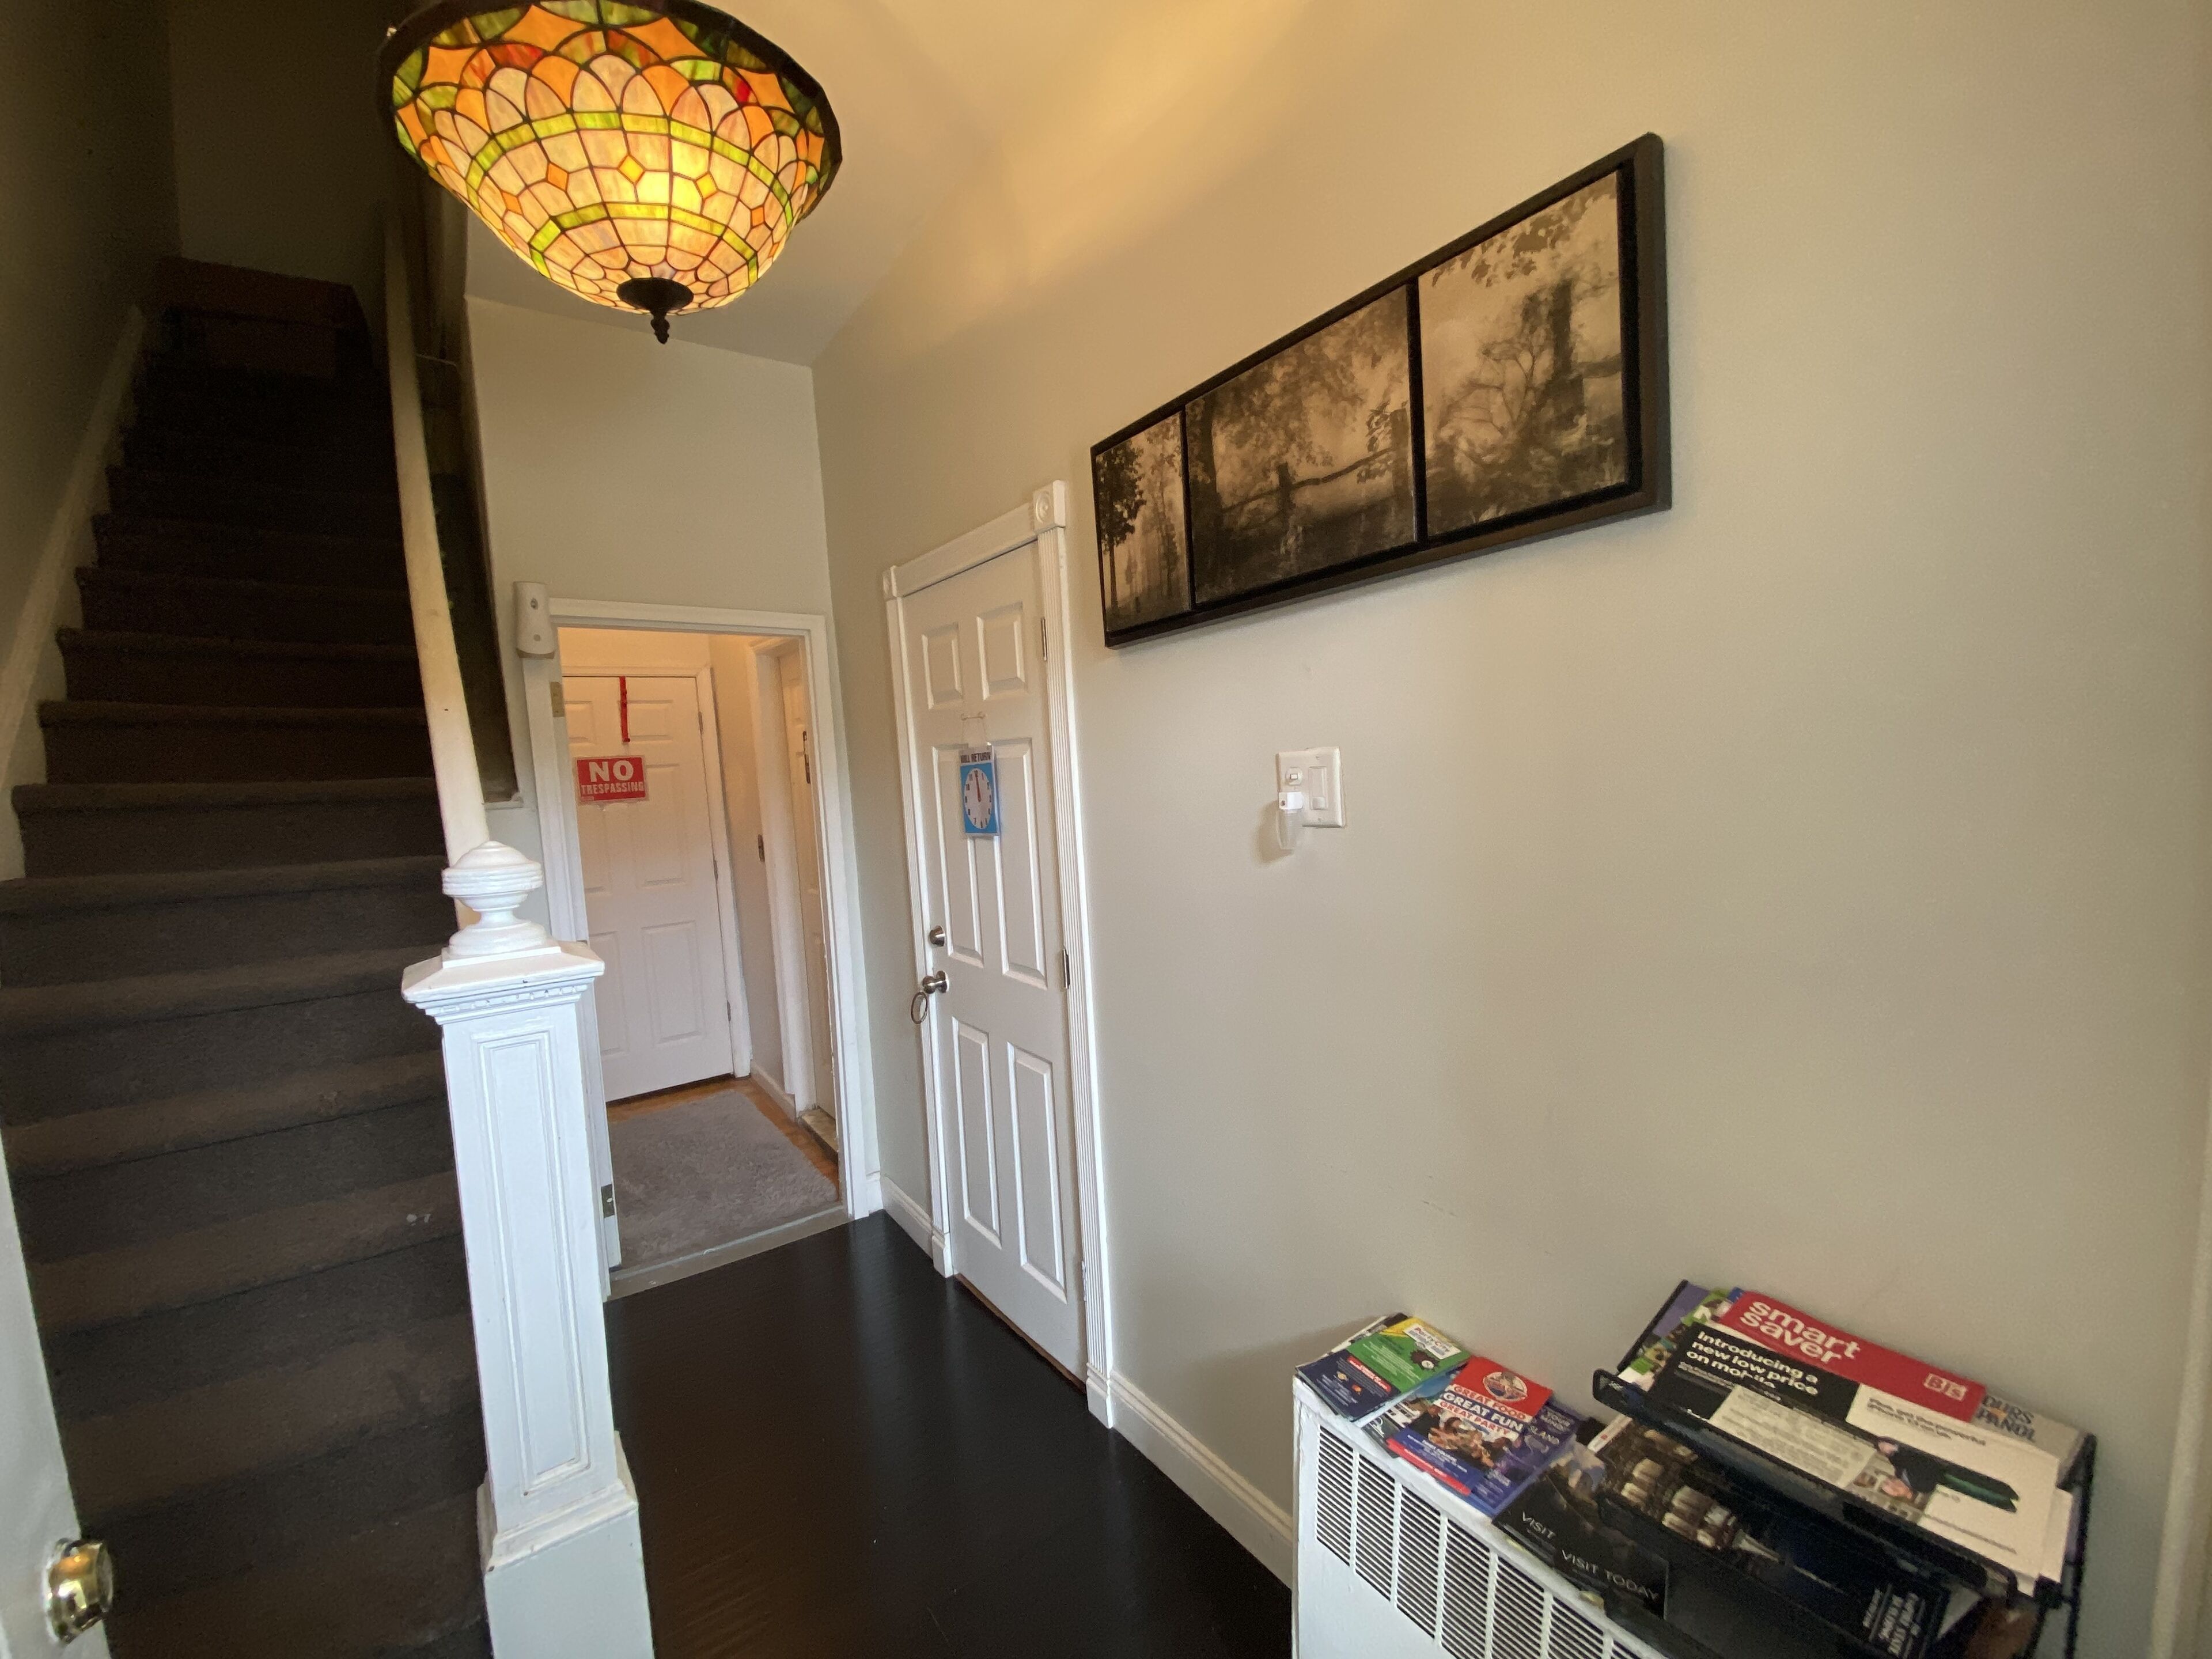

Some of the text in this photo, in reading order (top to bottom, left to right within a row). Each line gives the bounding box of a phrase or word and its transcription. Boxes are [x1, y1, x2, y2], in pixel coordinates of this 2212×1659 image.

[589, 760, 634, 782] NO
[960, 752, 991, 763] WILL RETURN
[581, 781, 645, 795] TRESPASSING
[1739, 1311, 1843, 1364] saver
[1748, 1301, 1861, 1359] smart
[1686, 1350, 1710, 1365] on
[1692, 1340, 1731, 1361] new
[1732, 1355, 1766, 1376] low
[1767, 1370, 1819, 1396] price
[1698, 1331, 1804, 1379] Introducing
[1805, 1373, 1819, 1385] a
[1439, 1400, 1474, 1421] GREAT
[1473, 1415, 1510, 1435] PARTY
[1442, 1392, 1490, 1417] GREAT
[1491, 1412, 1524, 1432] FUN
[1453, 1385, 1526, 1421] GREAT FOOD
[1521, 1511, 1556, 1539] VISIT
[1561, 1550, 1659, 1600] VISIT TODAY
